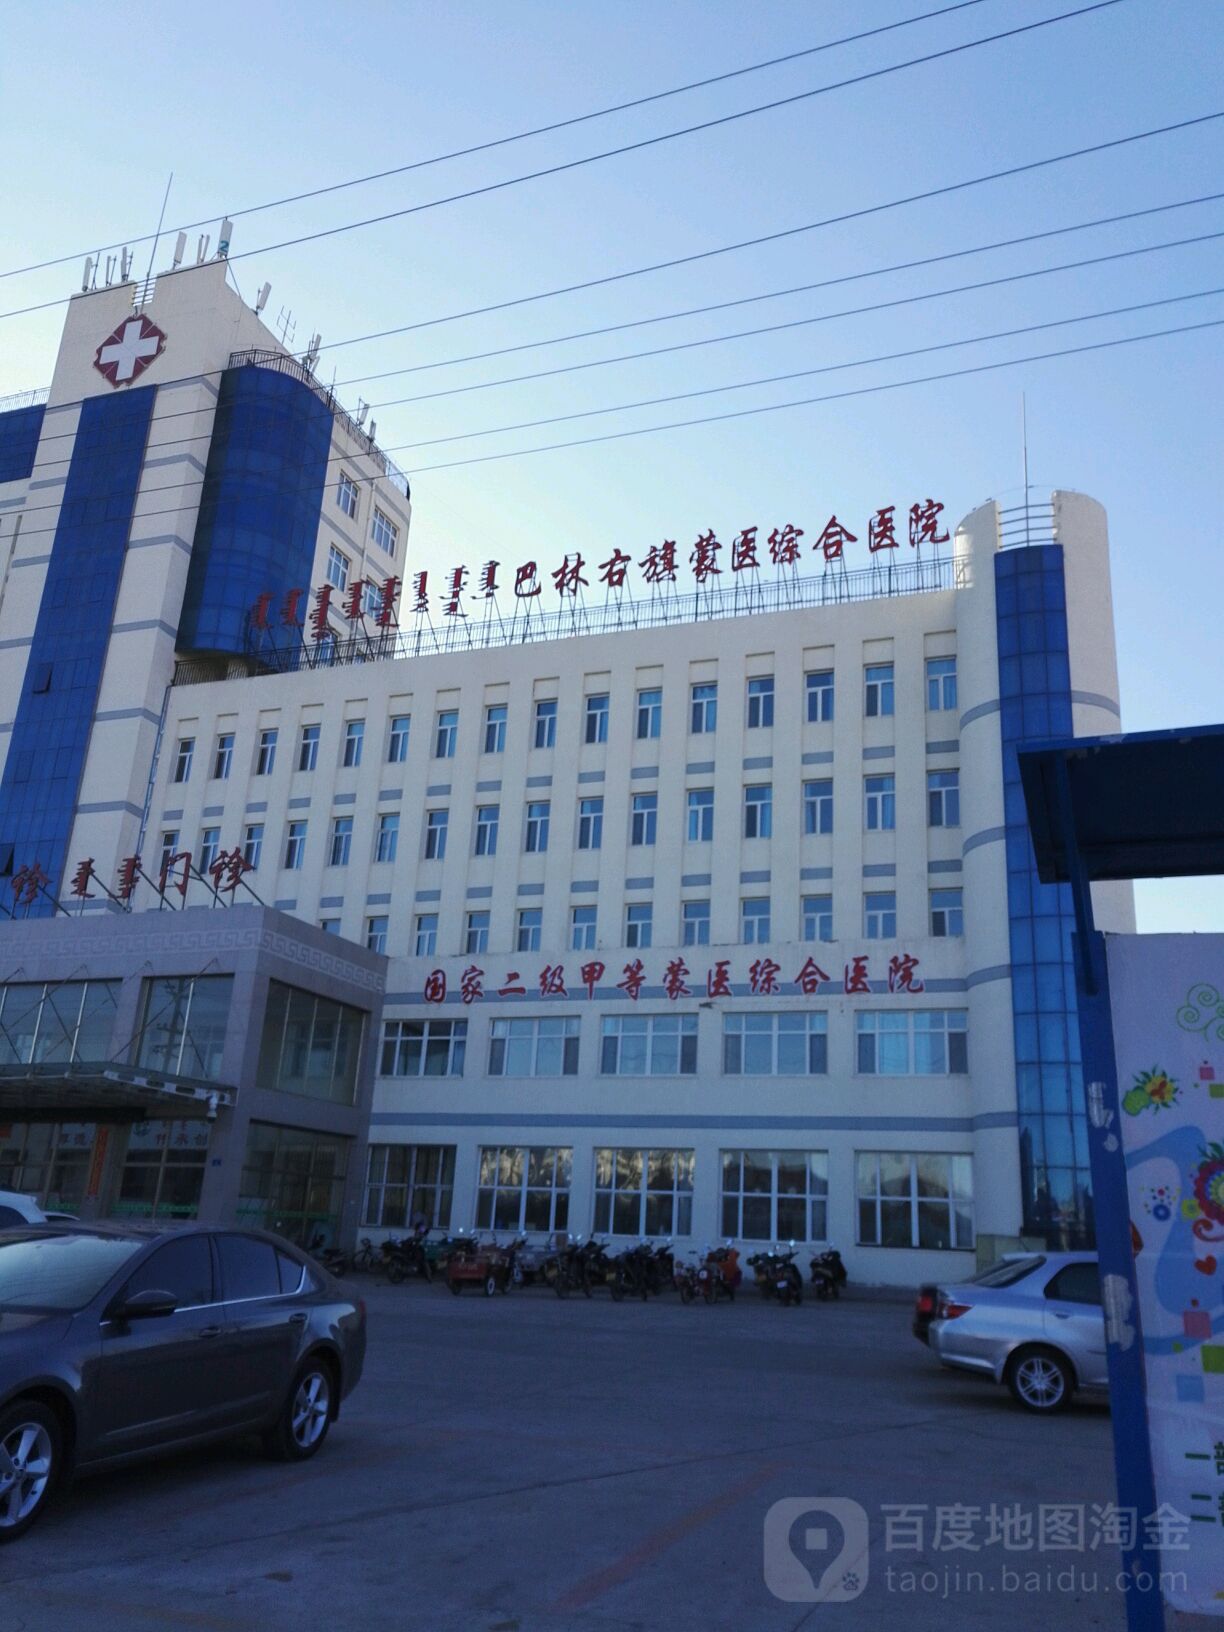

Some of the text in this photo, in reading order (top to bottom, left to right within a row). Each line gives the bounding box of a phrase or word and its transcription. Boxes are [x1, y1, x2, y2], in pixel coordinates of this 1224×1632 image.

[514, 498, 950, 598] 巴林右旗蒙医综合医院
[424, 953, 925, 1005] 国家二级甲等蒙医综合医院
